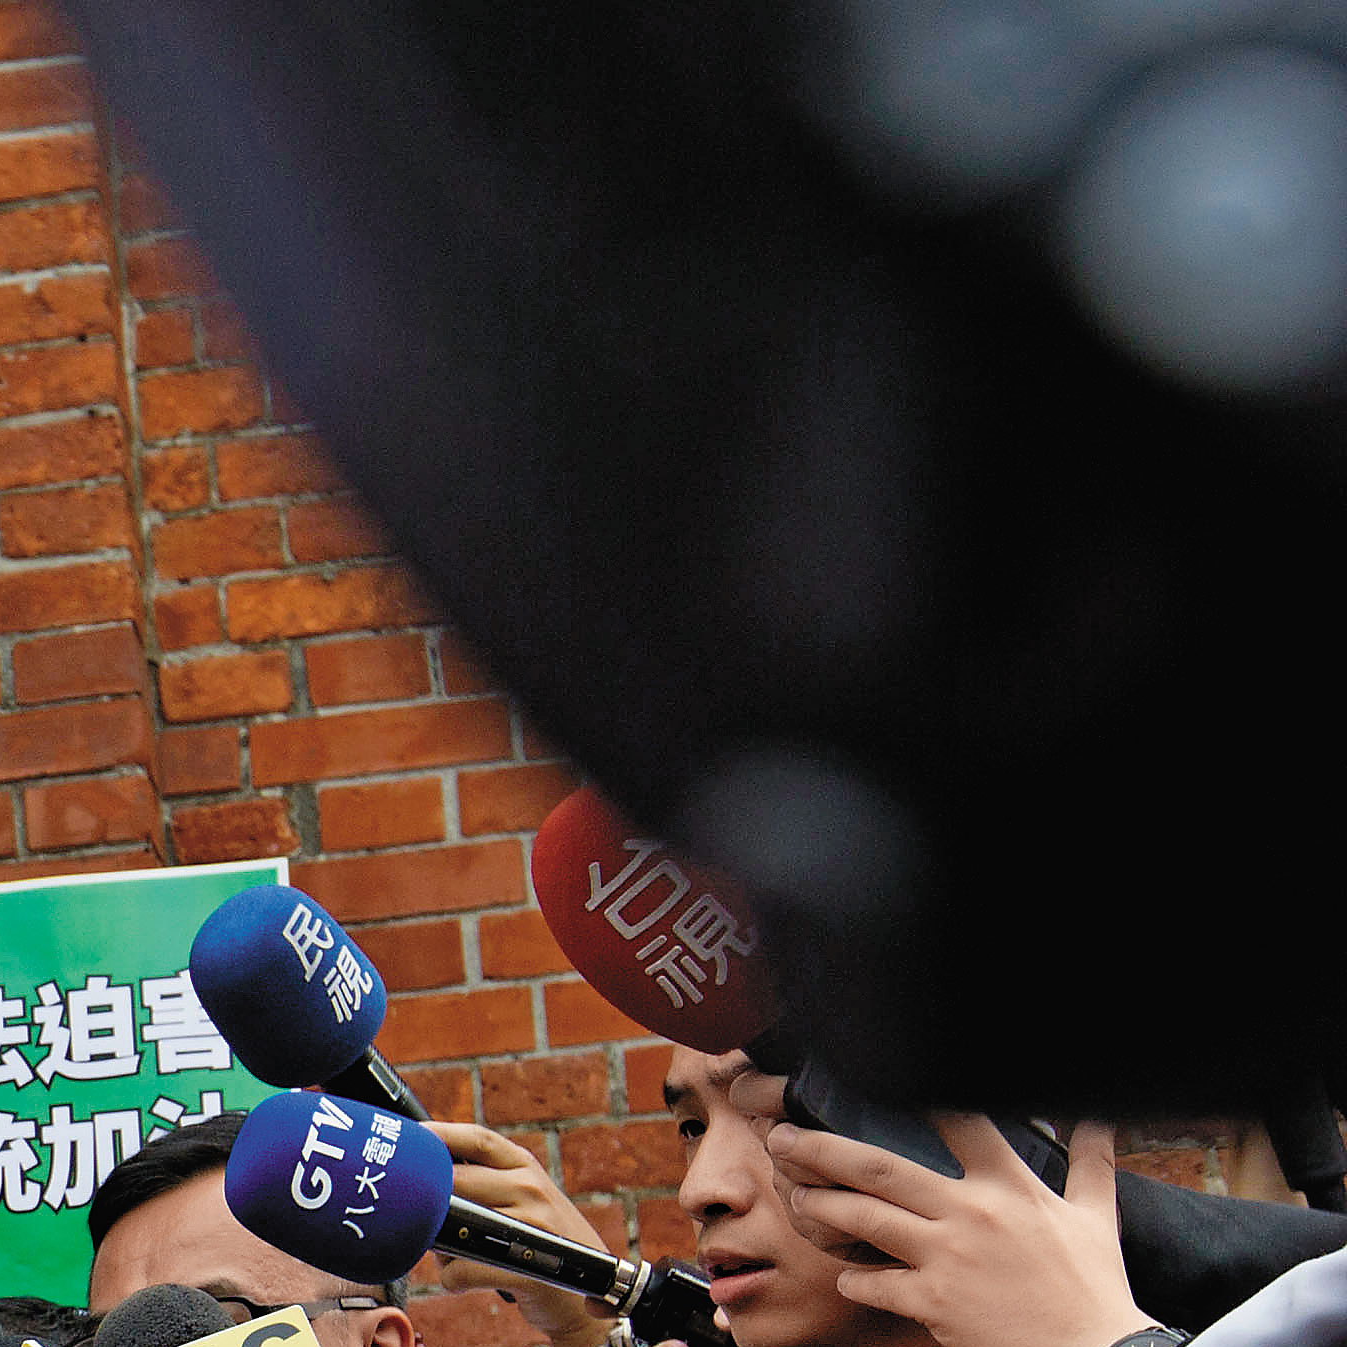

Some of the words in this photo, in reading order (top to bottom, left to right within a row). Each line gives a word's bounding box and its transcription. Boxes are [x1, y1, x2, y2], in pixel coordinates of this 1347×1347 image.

[282, 903, 373, 1024] 民視
[290, 1096, 356, 1210] GTV
[341, 1112, 402, 1240] 八大電視
